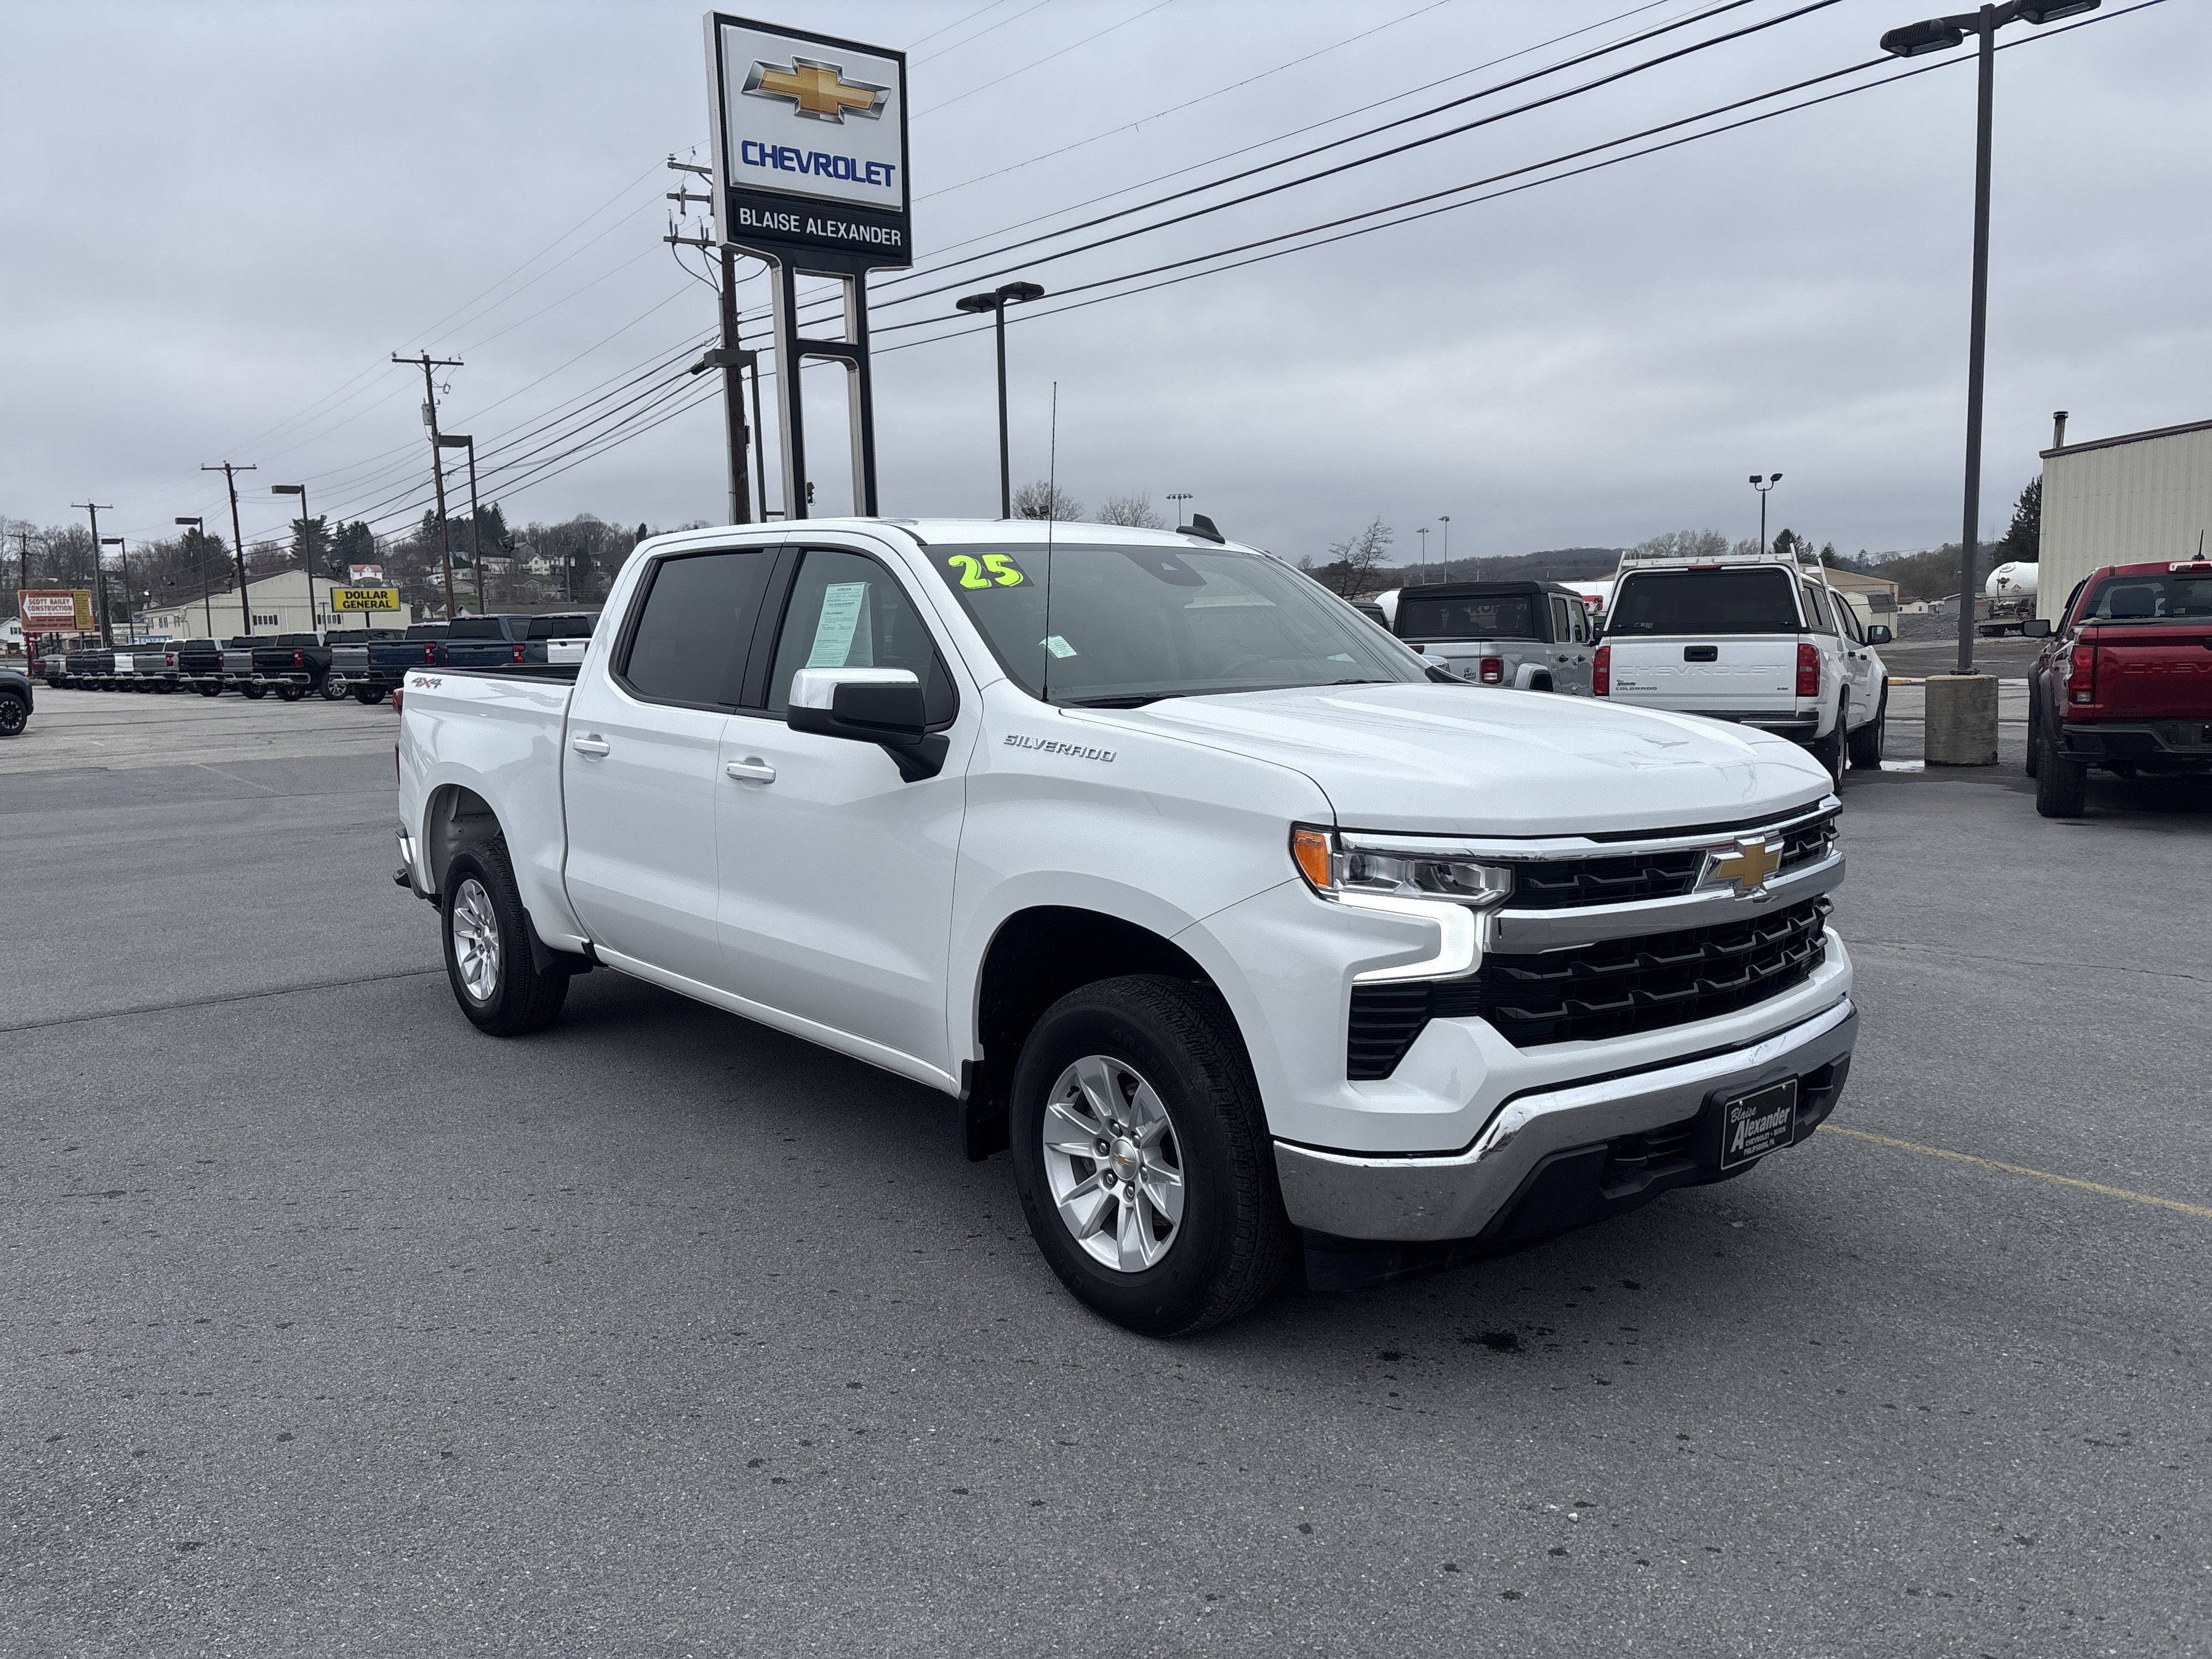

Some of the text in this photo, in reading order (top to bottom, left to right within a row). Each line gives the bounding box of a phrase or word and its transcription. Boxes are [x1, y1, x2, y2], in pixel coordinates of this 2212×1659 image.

[741, 140, 895, 187] CHEVROLET
[740, 207, 901, 246] BLAISE ALEXANDER
[948, 554, 1024, 589] 25
[342, 600, 392, 608] GENERAL
[345, 591, 388, 599] DOLLAR
[1618, 665, 1787, 676] CHEVROLET
[1003, 733, 1117, 762] SILVERADO
[1730, 1107, 1757, 1124] Blaise
[1730, 1107, 1791, 1153] Alexander
